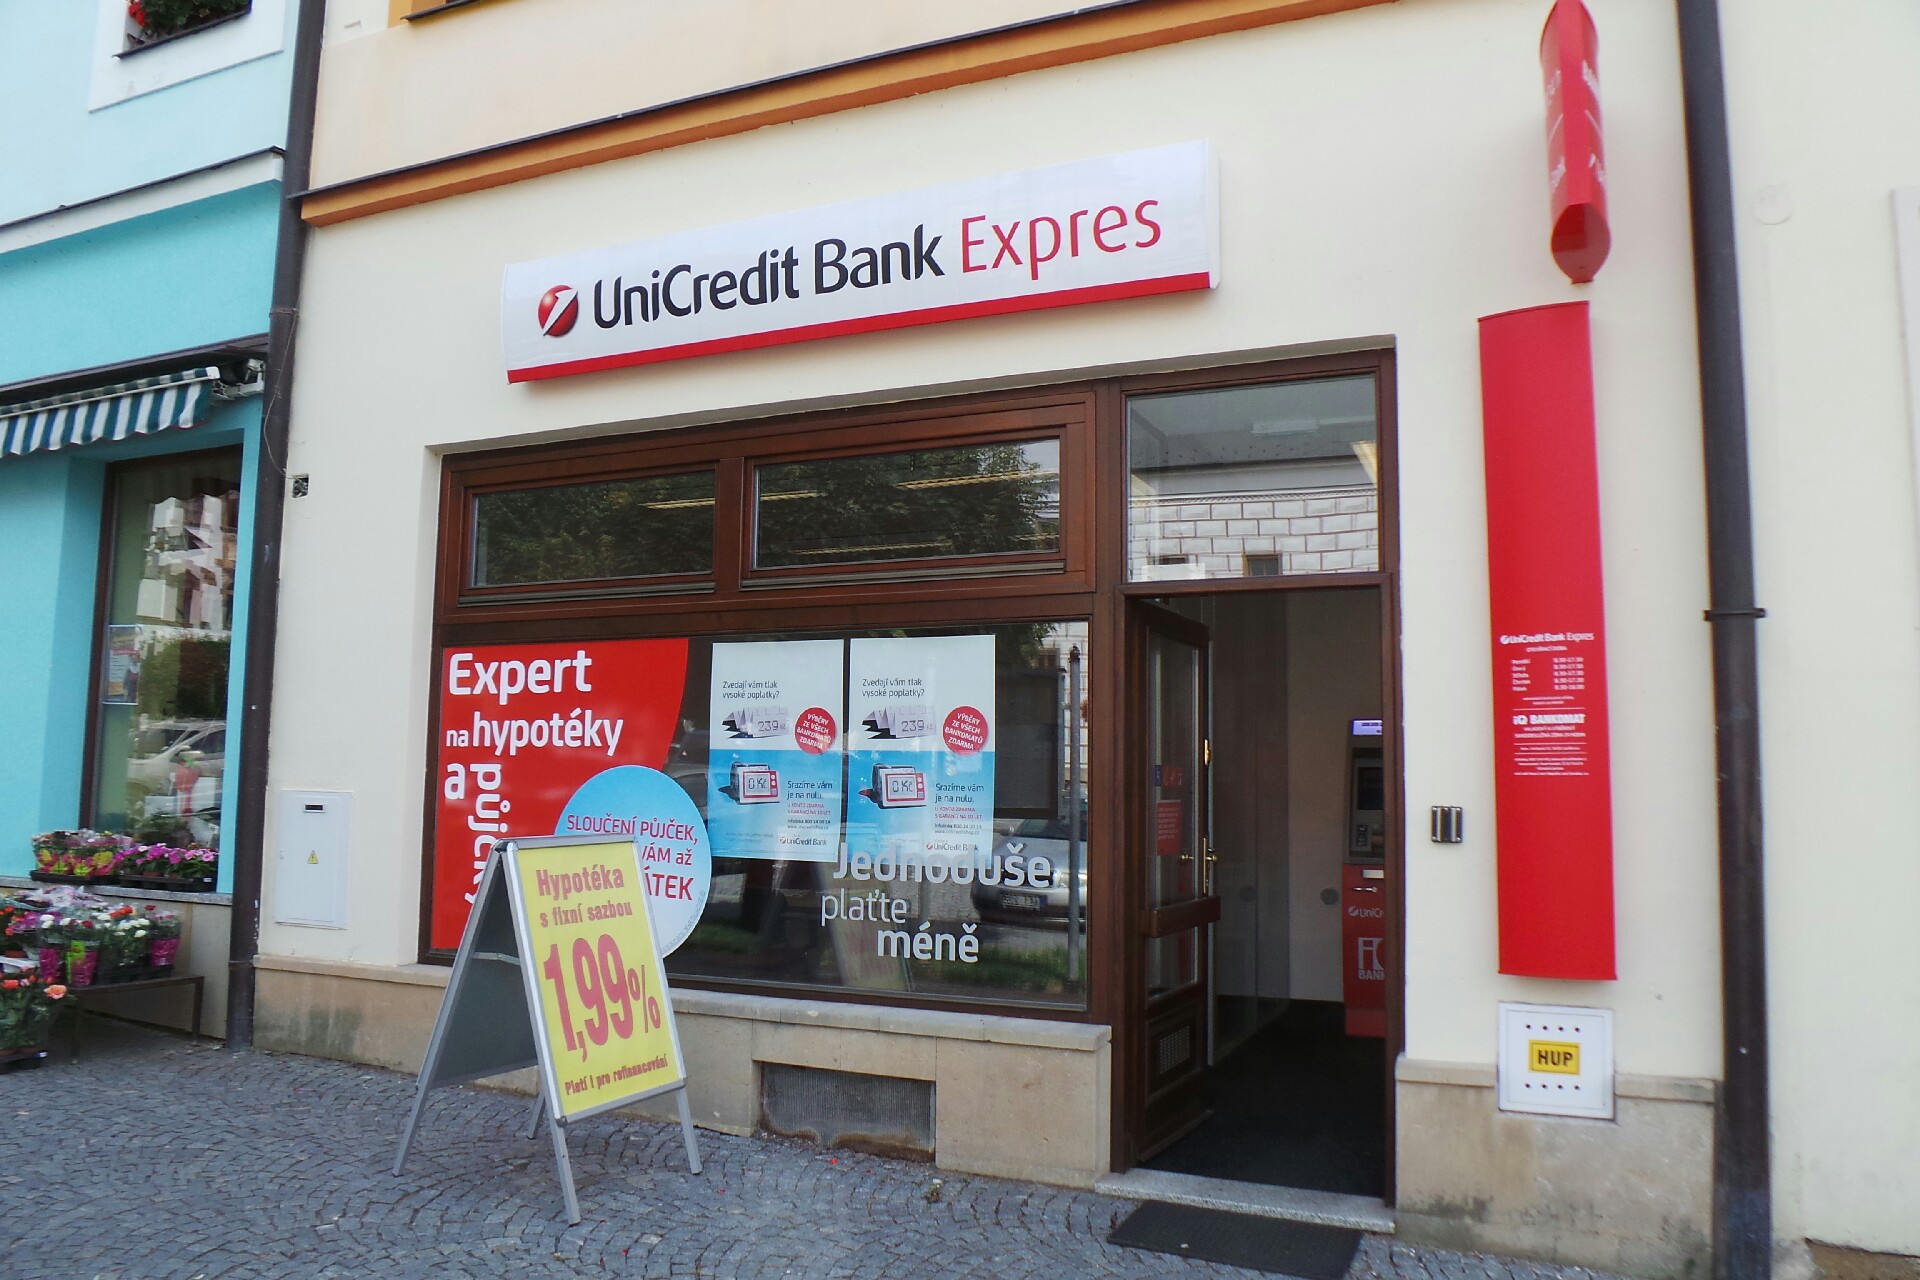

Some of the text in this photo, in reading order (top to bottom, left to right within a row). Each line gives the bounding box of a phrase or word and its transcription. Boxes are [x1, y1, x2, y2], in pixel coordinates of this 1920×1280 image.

[593, 199, 1162, 329] UniCredit Bank Expres
[449, 650, 592, 706] Expert
[722, 680, 777, 689] Zvedají vám tlak
[862, 678, 922, 688] Zvedají vám tlak
[722, 690, 780, 700] vysoké poplatky?
[862, 688, 925, 698] vysoké poplatky?
[957, 712, 981, 725] VÝBĚRY
[1529, 713, 1586, 724] BANKOMAT
[446, 708, 623, 756] na hypotéky
[757, 720, 779, 732] 239
[810, 723, 829, 734] VŠECH
[901, 720, 925, 732] 239
[952, 719, 981, 734] ZE VŠECH
[944, 727, 983, 744] BANKOMATŮ
[948, 737, 974, 750] ZDARMA
[444, 763, 465, 800] a
[748, 778, 754, 790] 0
[787, 780, 833, 789] Srazíme vám
[892, 780, 899, 792] 0
[935, 782, 985, 792] Srazíme vám
[786, 791, 794, 800] je
[795, 792, 804, 800] na
[934, 793, 975, 803] je na nulu.
[464, 763, 511, 904] půj
[566, 813, 698, 845] SLOUČENÍ PŮJČEK,
[786, 837, 827, 846] UniCredit Bank
[962, 843, 979, 852] Bk
[675, 848, 692, 866] až
[833, 841, 1051, 888] Jednoduše
[535, 864, 625, 902] Hypotéka
[540, 900, 633, 928] s fixní sazbou
[821, 888, 908, 927] plaťte
[877, 921, 979, 963] méně
[543, 934, 661, 1063] 1,99%
[1537, 1049, 1573, 1067] HUP
[564, 1076, 588, 1096] Platí
[597, 1075, 611, 1091] pro
[613, 1055, 668, 1086] refinancování
